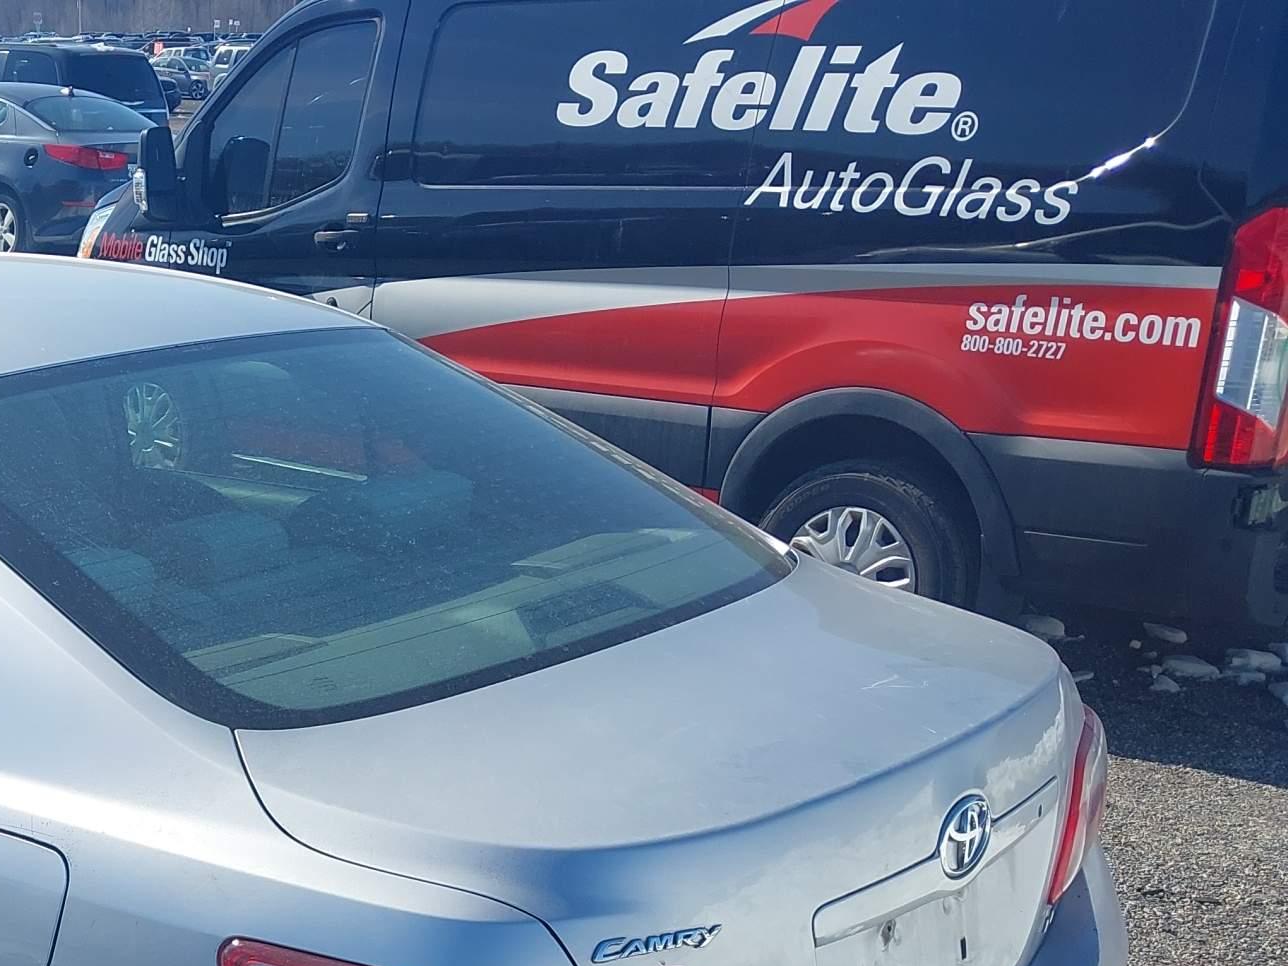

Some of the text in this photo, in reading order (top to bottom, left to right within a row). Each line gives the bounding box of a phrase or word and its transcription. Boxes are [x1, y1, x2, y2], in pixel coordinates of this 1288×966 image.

[744, 152, 1079, 225] AutoGlass
[98, 232, 143, 260] Mobile
[145, 235, 187, 264] Glass
[966, 295, 1201, 348] safelite.com
[961, 335, 1066, 360] 800-800-2727
[591, 924, 722, 964] CAMRY
